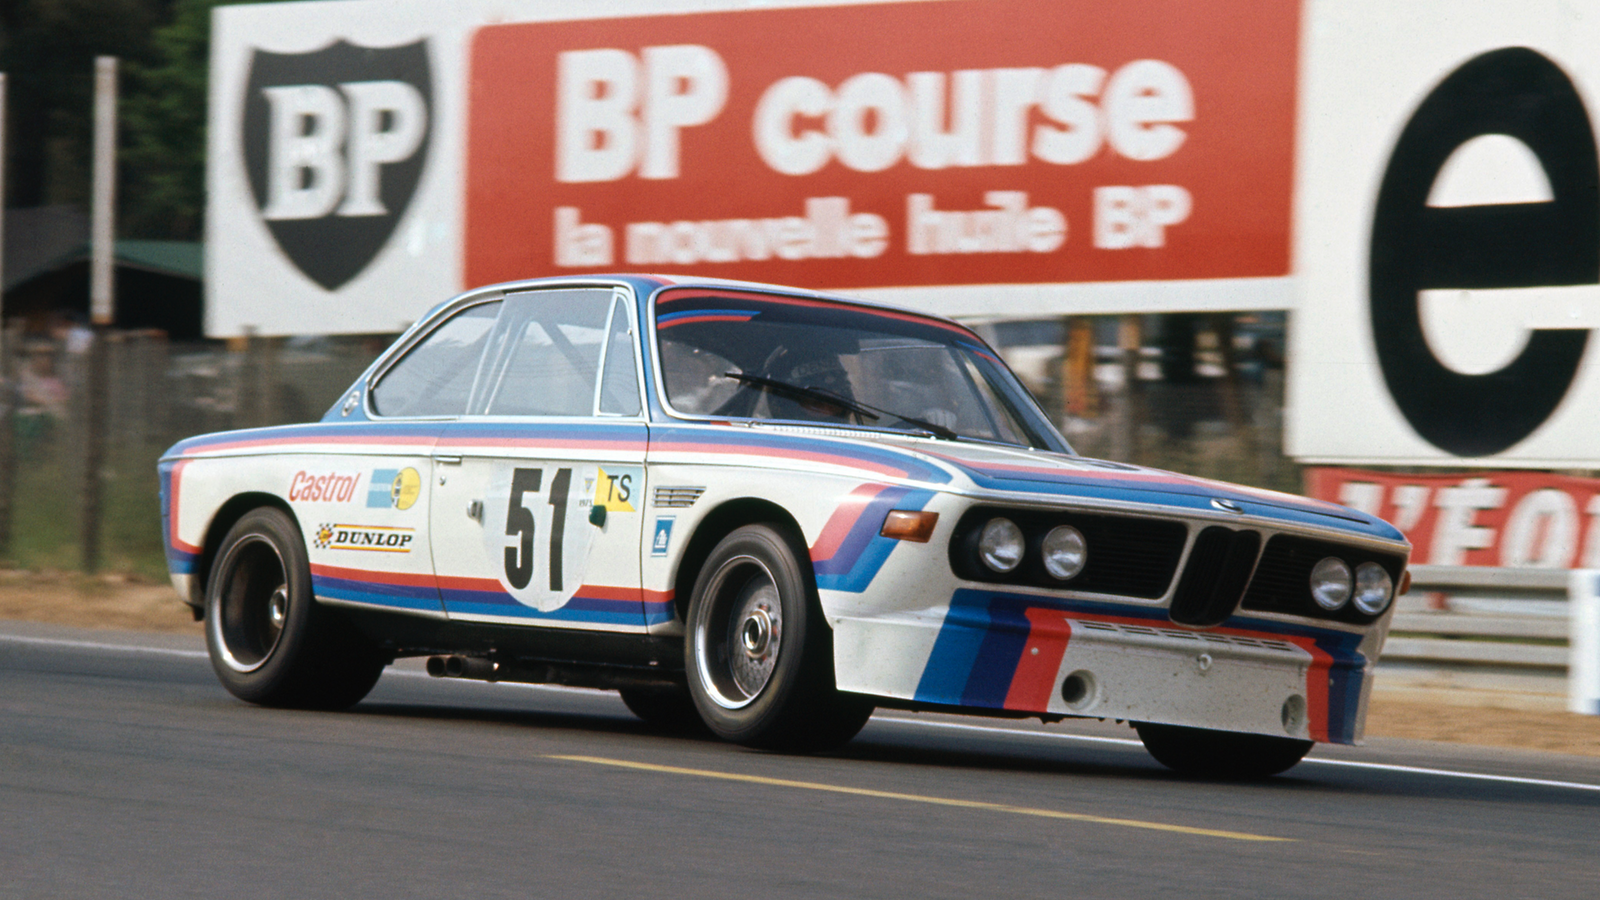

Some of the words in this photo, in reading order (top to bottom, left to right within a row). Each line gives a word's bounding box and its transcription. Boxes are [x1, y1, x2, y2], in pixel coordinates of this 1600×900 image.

[260, 79, 428, 221] BP
[556, 44, 730, 183] BP
[752, 58, 1196, 176] course
[555, 206, 613, 267] la
[624, 196, 890, 265] nouvelle
[907, 190, 1067, 255] huile
[1092, 184, 1193, 249] BP
[1367, 46, 1600, 458] e
[289, 470, 361, 502] Castrol
[504, 467, 572, 592] 51
[607, 473, 632, 502] TS
[336, 531, 413, 547] DUNLOP
